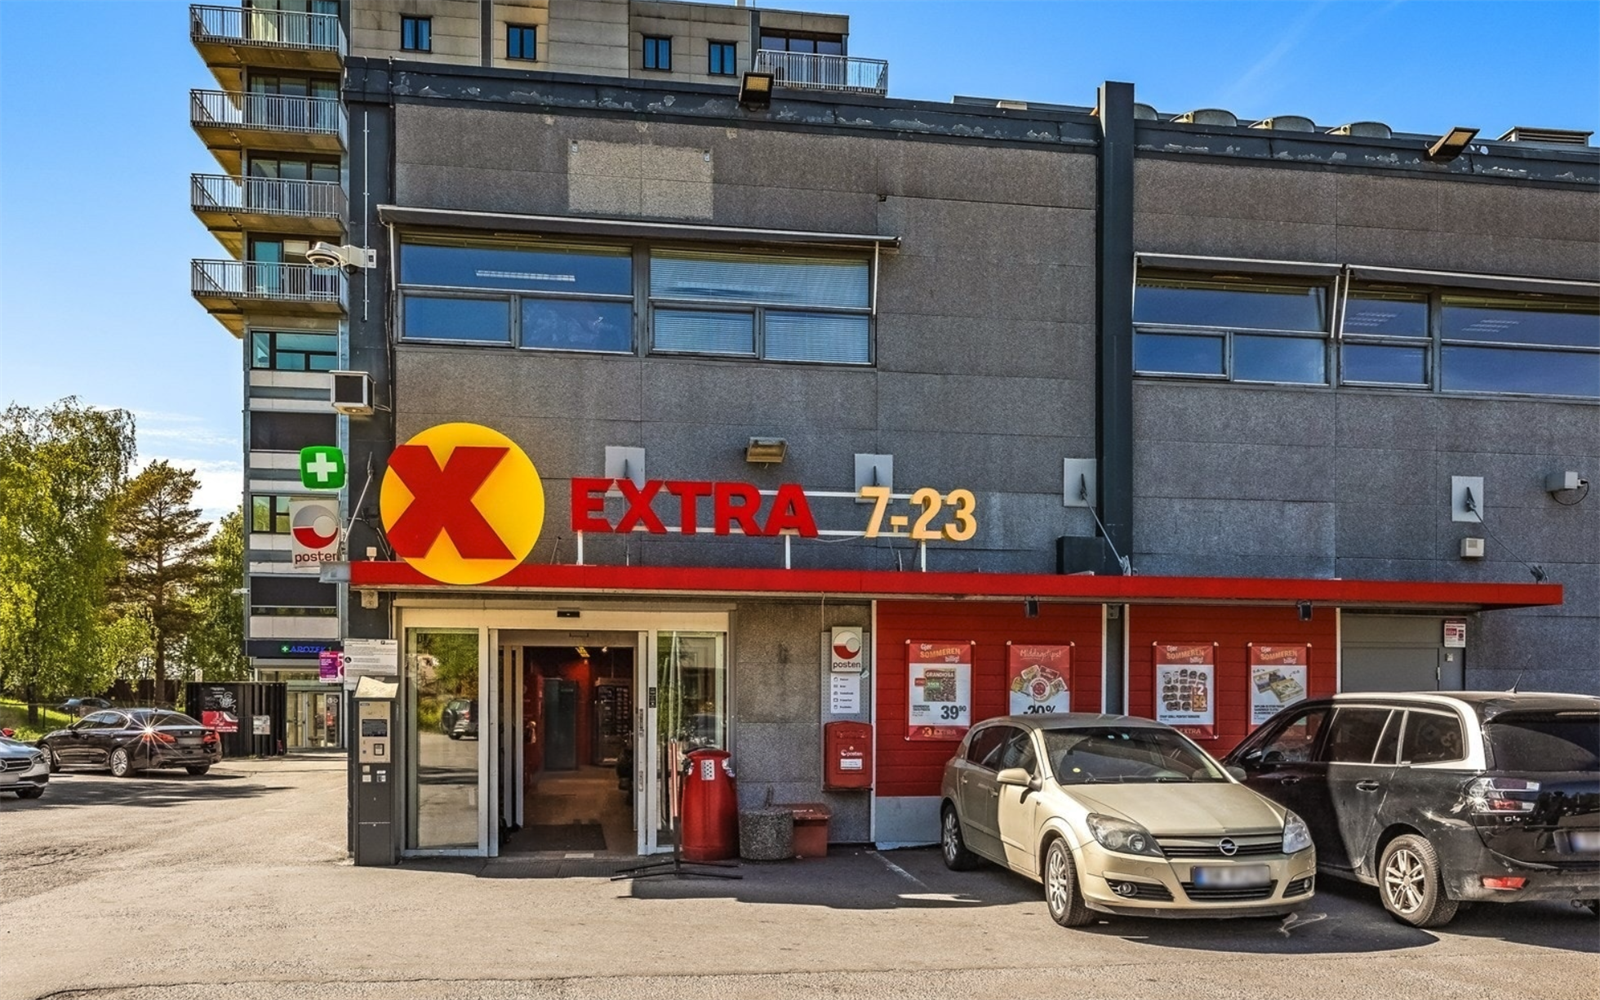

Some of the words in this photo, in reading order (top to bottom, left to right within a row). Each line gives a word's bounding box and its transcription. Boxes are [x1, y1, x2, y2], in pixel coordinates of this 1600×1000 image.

[572, 477, 818, 538] EXTRA
[860, 485, 977, 542] 7-23
[291, 645, 326, 653] APOTEK
[920, 647, 961, 659] SOMMEREN
[1166, 649, 1205, 660] SOMMEREN
[1260, 650, 1298, 660] SOMMEREN
[832, 660, 861, 669] posten
[940, 705, 959, 720] 39
[846, 750, 863, 758] posten
